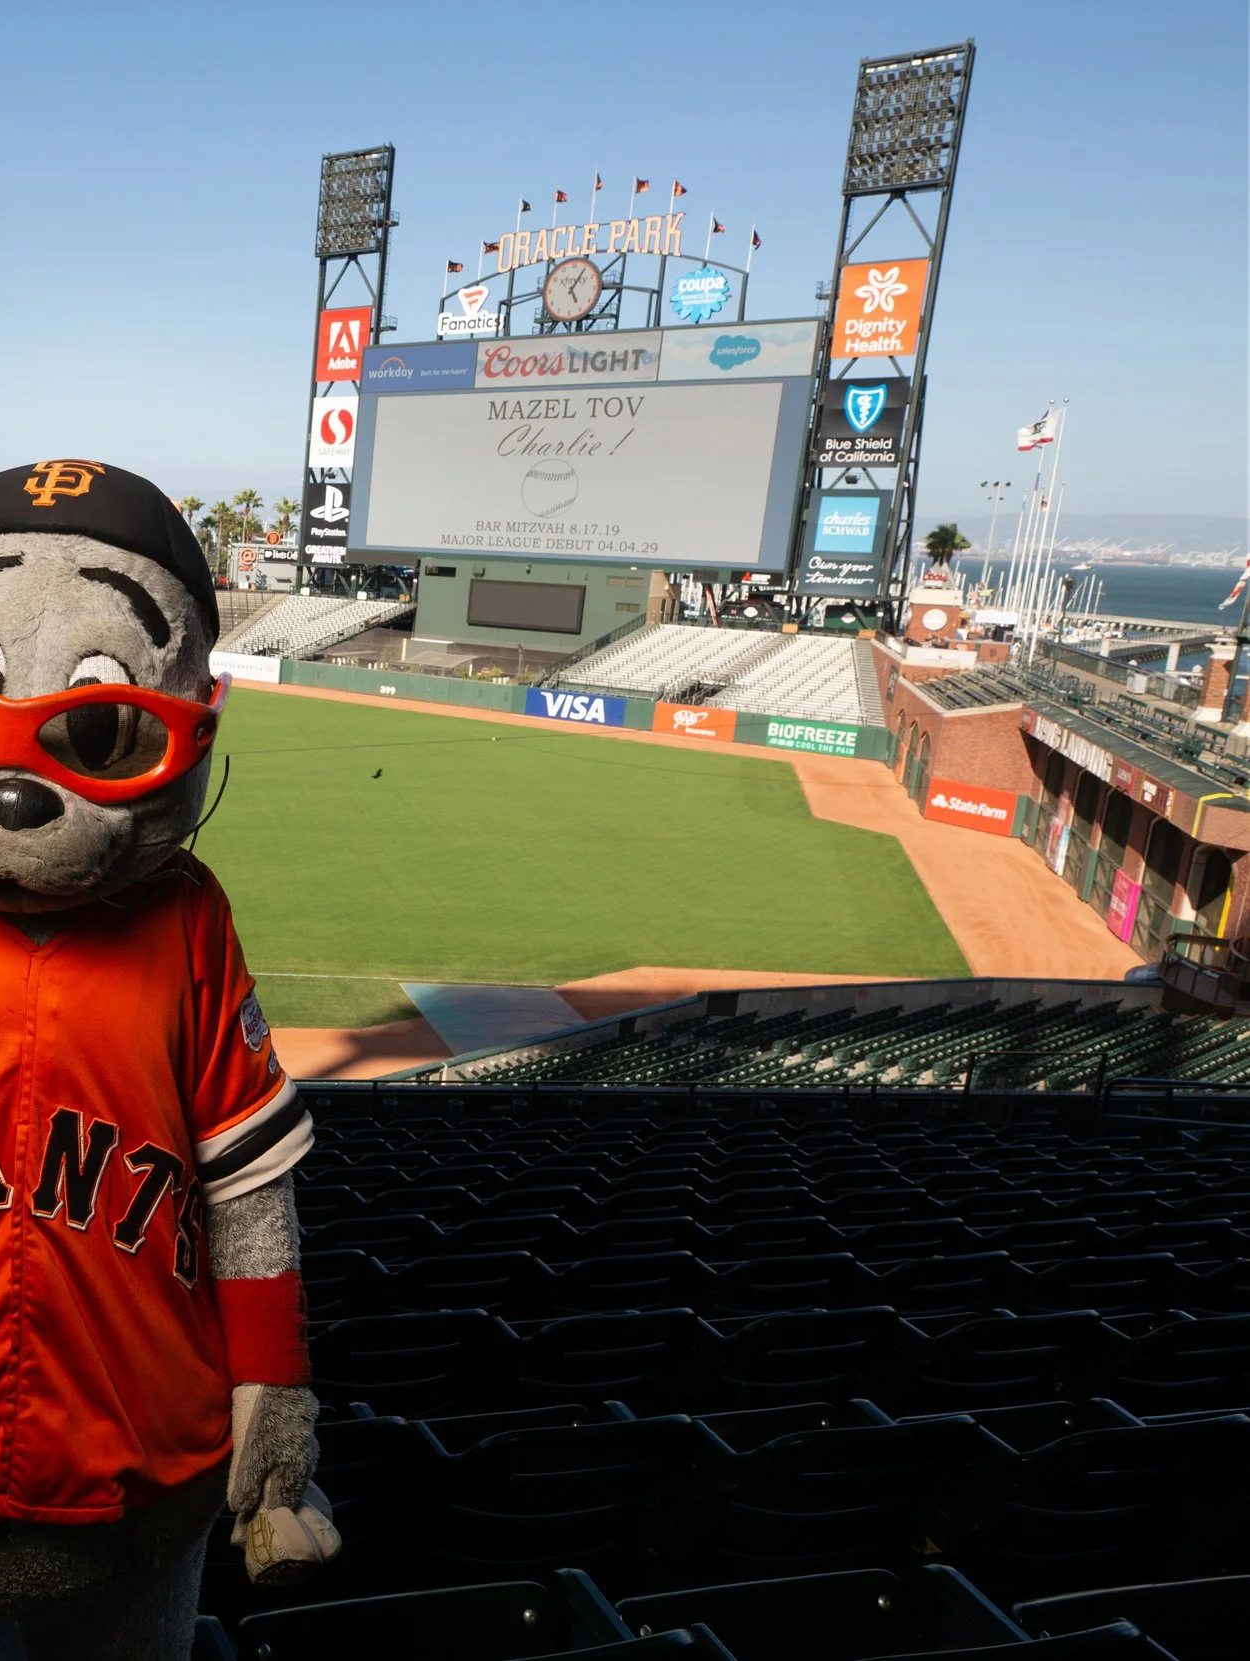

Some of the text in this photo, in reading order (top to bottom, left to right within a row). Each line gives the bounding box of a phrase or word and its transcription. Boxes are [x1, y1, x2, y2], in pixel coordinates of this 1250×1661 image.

[497, 212, 686, 273] ORACLE PARK
[678, 276, 725, 293] coupa
[440, 315, 500, 332] Fanatics
[845, 318, 908, 337] Dignity
[716, 345, 757, 357] salesforce
[327, 357, 358, 371] Adobe
[484, 345, 646, 379] Coors LIGHT
[368, 366, 415, 380] workday
[488, 396, 645, 421] MAZEL TOV
[497, 424, 602, 458] Charlie
[825, 438, 893, 450] Blue Shield
[318, 448, 351, 456] SAFEWAY
[819, 451, 895, 462] of California
[822, 511, 872, 526] charles
[310, 528, 346, 538] PlayStation
[475, 521, 620, 536] BAR MITZVAH 8.17.19
[822, 526, 870, 536] SCHWAB
[440, 534, 659, 554] MAJOR LEAGUE DEBUT 04.04.29
[808, 555, 874, 579] Own your
[379, 685, 396, 695] 399
[540, 692, 606, 724] VISA
[795, 740, 855, 756] COOL THE PAIN
